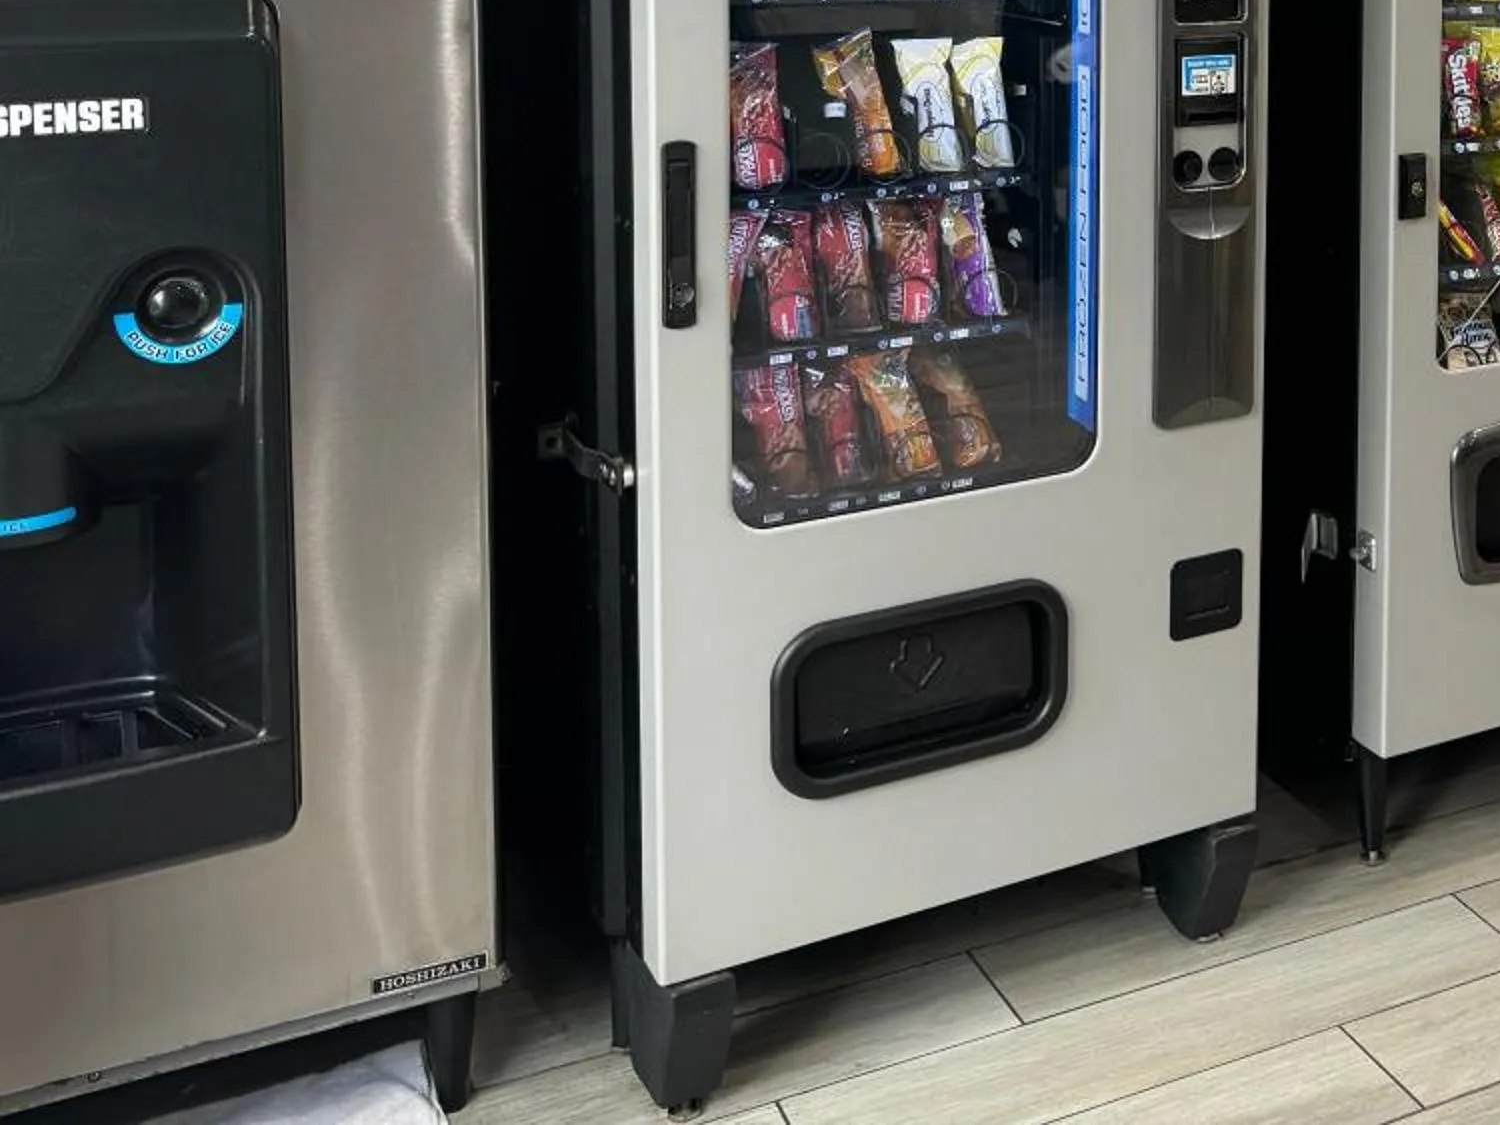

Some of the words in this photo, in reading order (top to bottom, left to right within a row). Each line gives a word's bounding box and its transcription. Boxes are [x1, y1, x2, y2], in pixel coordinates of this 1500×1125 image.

[1448, 54, 1473, 129] Skittles
[127, 331, 168, 358] PUSH
[174, 341, 207, 359] FOR
[209, 322, 233, 345] ICE
[379, 955, 481, 993] HOSHIZAKI
